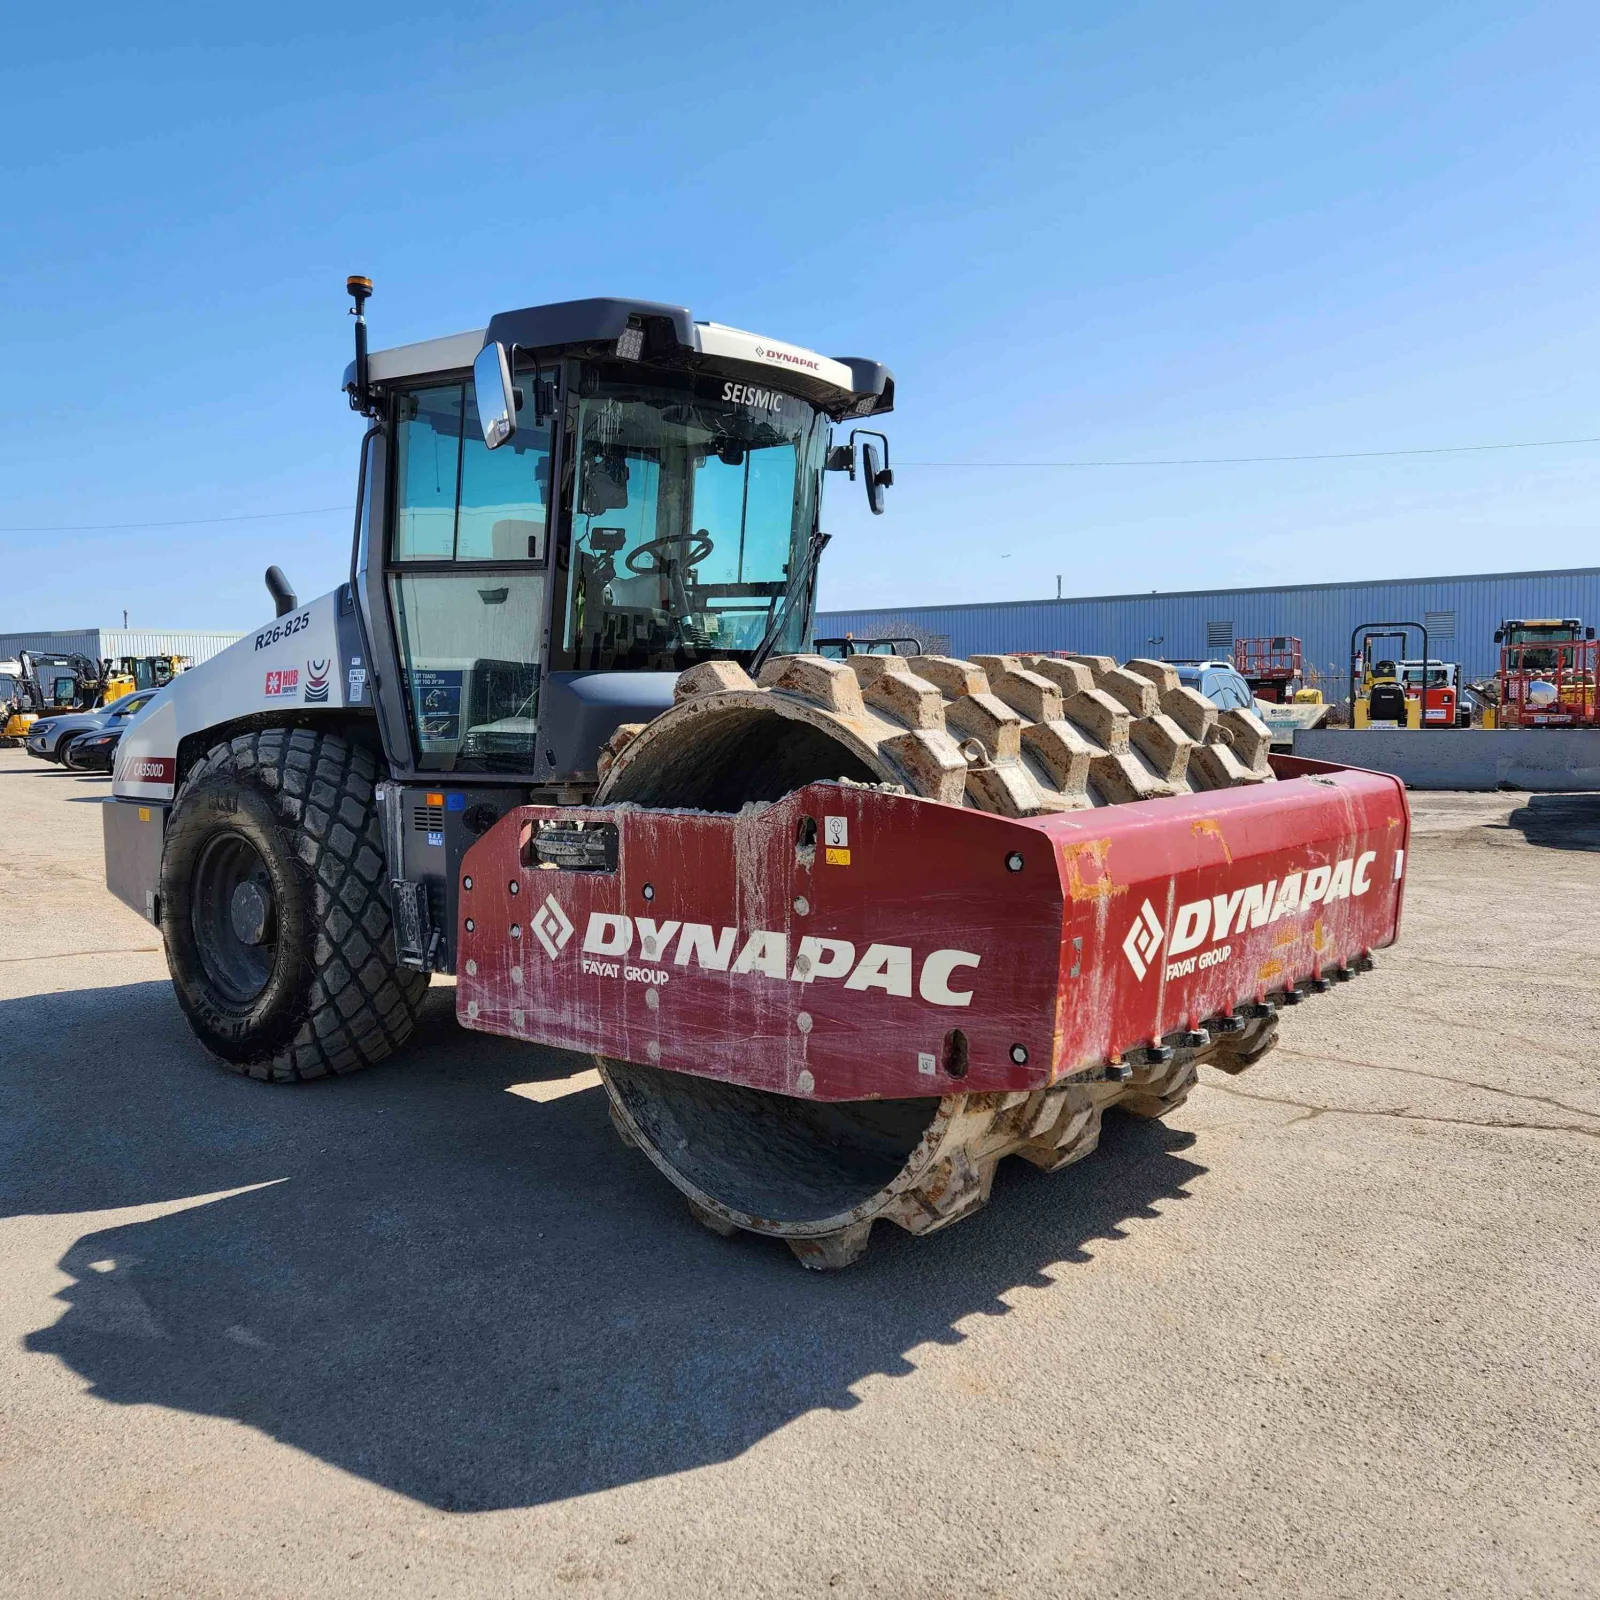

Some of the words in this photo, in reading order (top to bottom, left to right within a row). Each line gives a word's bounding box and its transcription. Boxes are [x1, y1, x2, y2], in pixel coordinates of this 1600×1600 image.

[766, 350, 819, 370] DYNAPAC
[721, 382, 783, 412] SEISMIC
[254, 611, 310, 651] R26-825
[282, 669, 299, 686] HUB
[134, 763, 164, 777] CA3500D
[1168, 851, 1376, 956] DYNAPAC
[582, 912, 981, 1006] DYNAPAC
[582, 960, 620, 979] FAYAT
[624, 966, 669, 985] GROUP
[1166, 956, 1197, 982] FAYAT
[1199, 945, 1232, 970] GROUP
